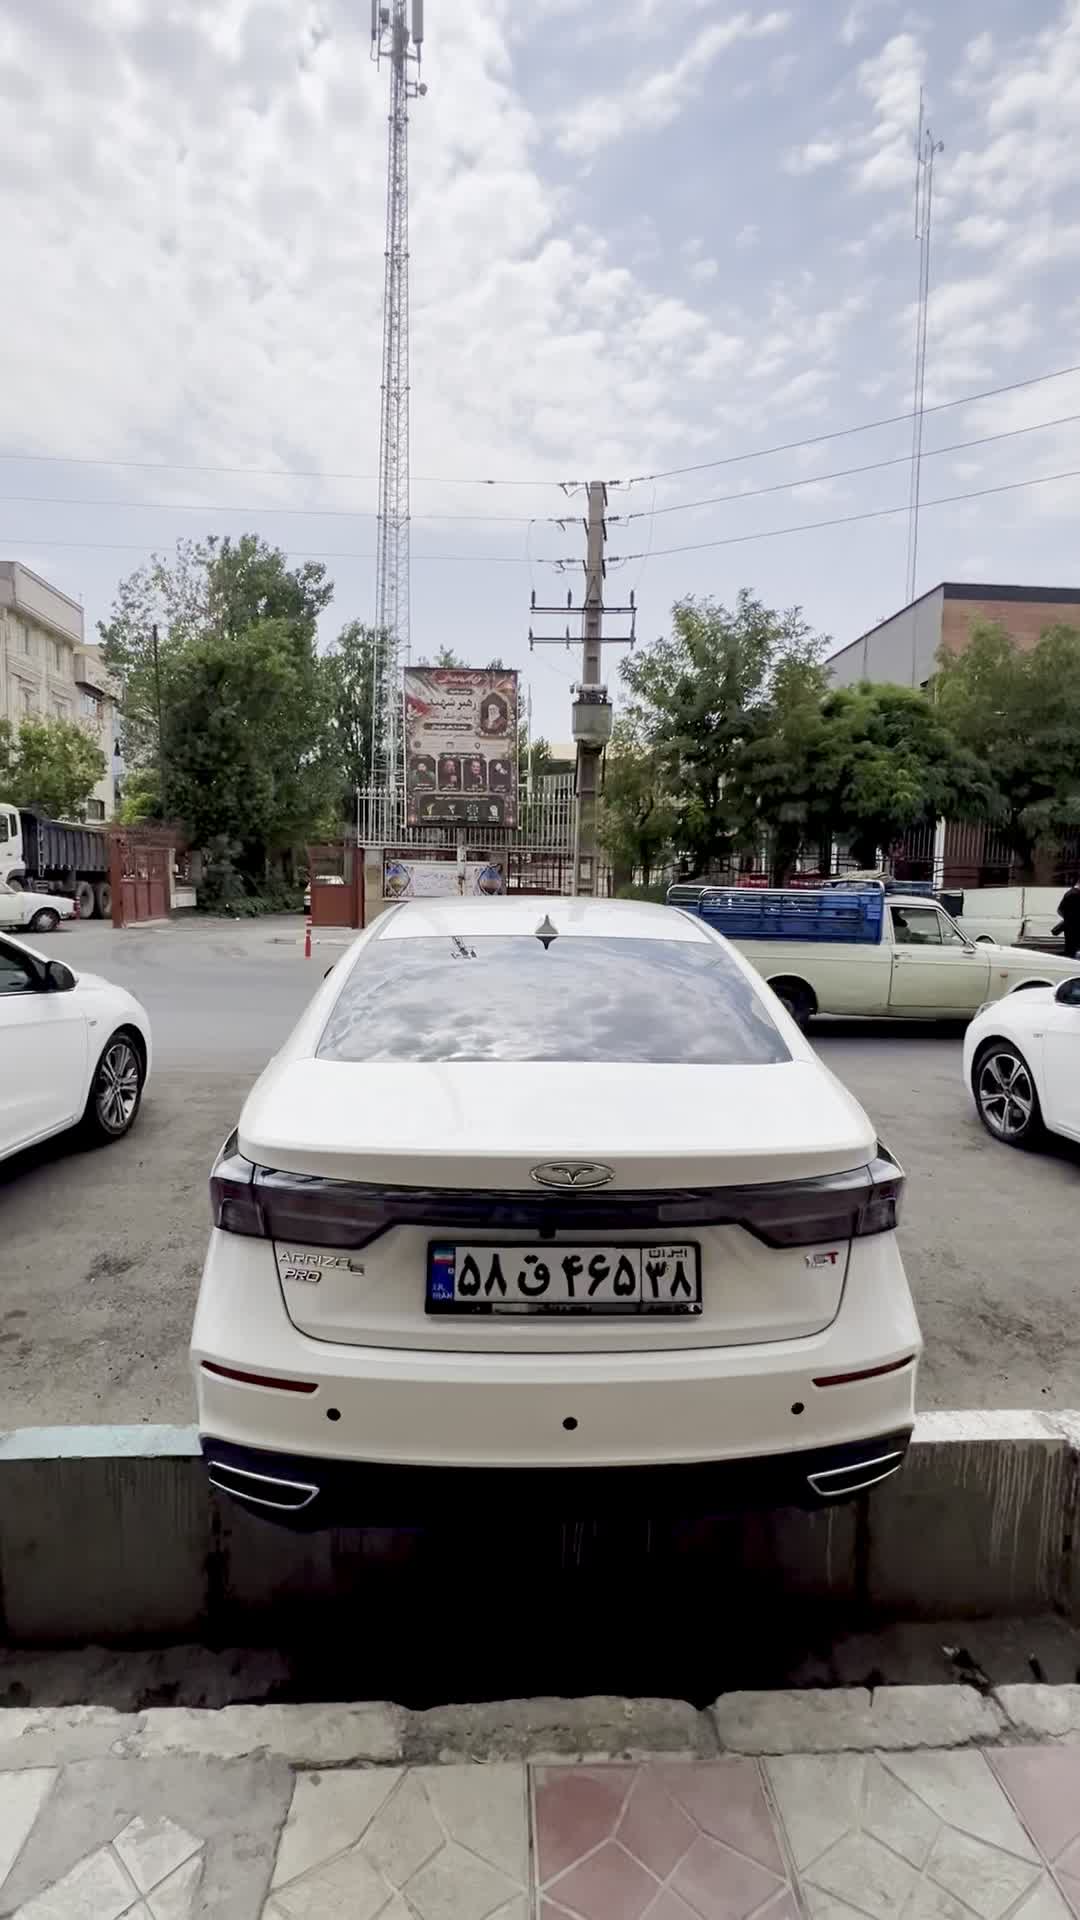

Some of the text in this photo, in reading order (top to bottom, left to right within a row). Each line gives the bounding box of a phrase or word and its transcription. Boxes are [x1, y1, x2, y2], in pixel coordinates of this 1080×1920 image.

[279, 1251, 351, 1271] ARRIZO
[284, 1267, 322, 1284] PRO
[457, 1253, 692, 1299] ۵۸ ق ۴۶۵ ۳۸
